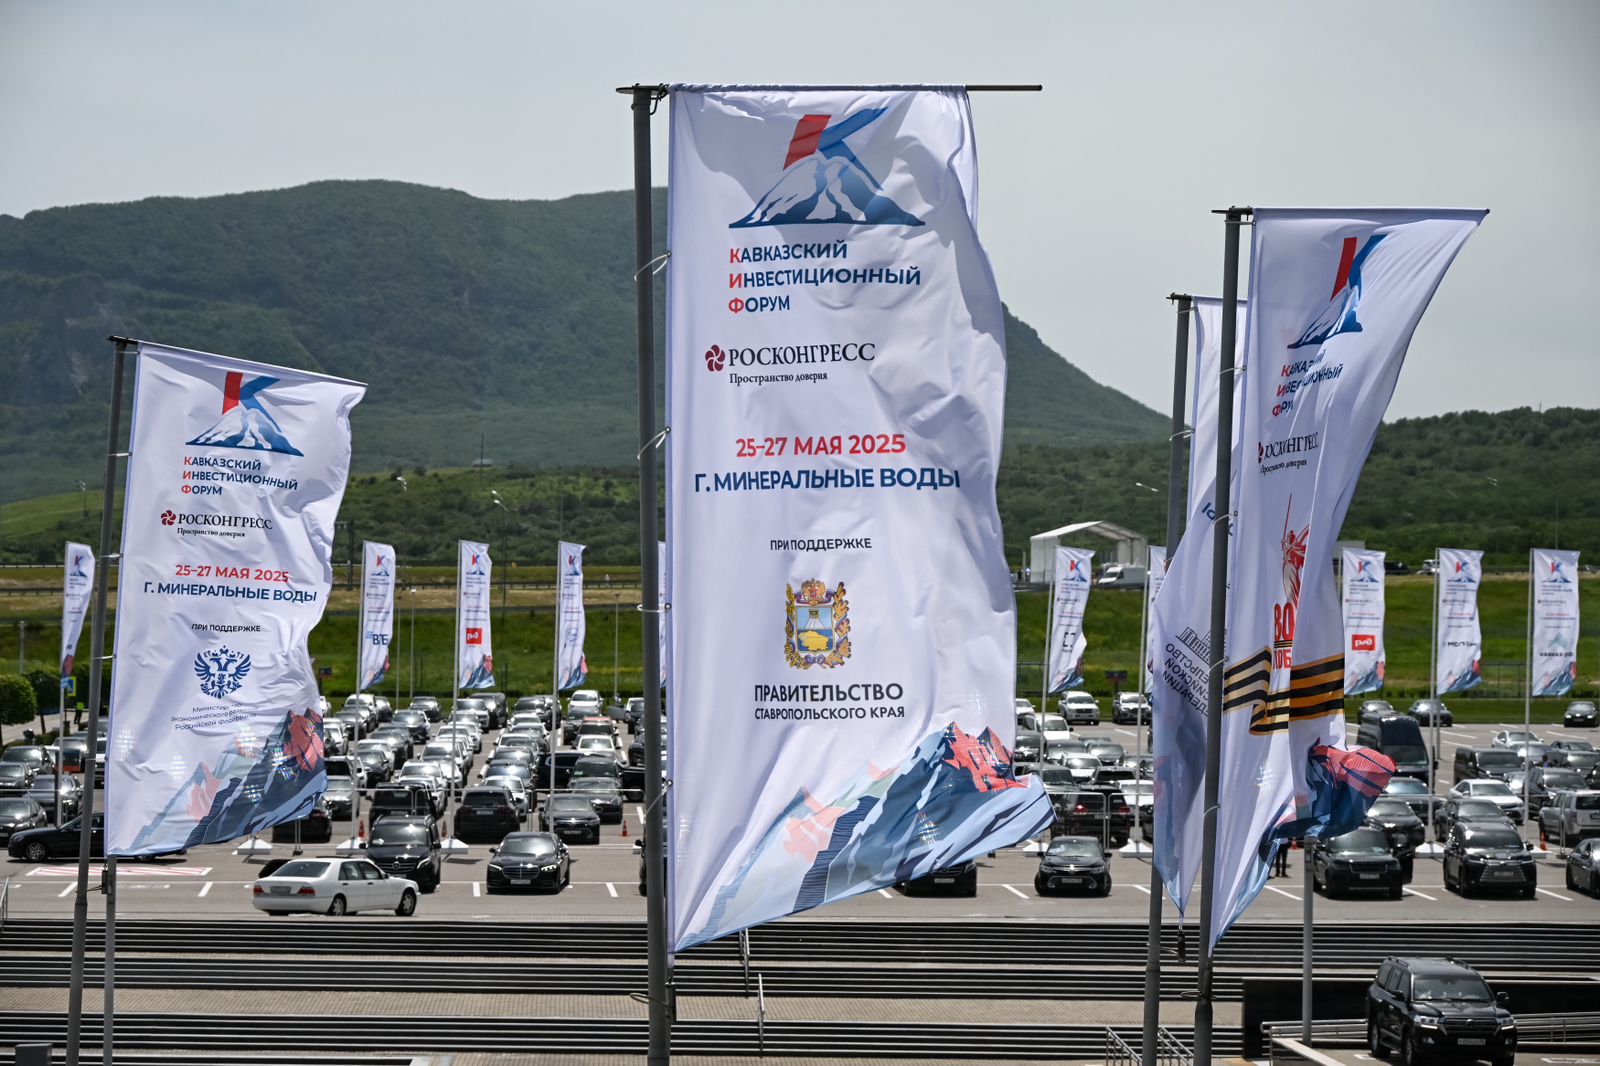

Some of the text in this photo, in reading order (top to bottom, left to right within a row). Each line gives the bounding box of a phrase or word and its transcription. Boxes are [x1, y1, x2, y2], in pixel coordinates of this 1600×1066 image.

[729, 240, 847, 264] КАВКАЗСКИЙ
[729, 266, 921, 288] ИНВЕСТИЦИОННЫЙ
[728, 295, 790, 314] ФОРУМ
[728, 342, 876, 366] РОСКОНГРЕСС
[730, 371, 828, 385] Пространство доверия
[794, 436, 842, 456] МАЯ
[848, 434, 906, 454] 2025
[184, 456, 262, 470] КАВКАЗСКИЙ
[182, 471, 298, 490] ИНВЕСТИЦИОННЫЙ
[695, 468, 960, 492] Г. МИНЕРАЛЬНЫЕ ВОДЫ
[181, 484, 222, 496] ФОРУМ
[178, 512, 272, 530] РОСКОНГРЕСС
[177, 528, 246, 538] Пространство доверия
[770, 538, 872, 552] ПРИ ПОДДЕРЖКЕ
[215, 566, 250, 579] МАЯ
[254, 568, 289, 583] 2025
[144, 582, 317, 603] Г. МИНЕРАЛЬНЫЕ ВОДЫ
[209, 624, 261, 633] ПОДДЕРЖКЕ
[754, 683, 904, 702] ПРАВИТЕЛЬСТВО
[754, 706, 905, 720] СТАВРОПОЛЬСКОГО КРАЯ
